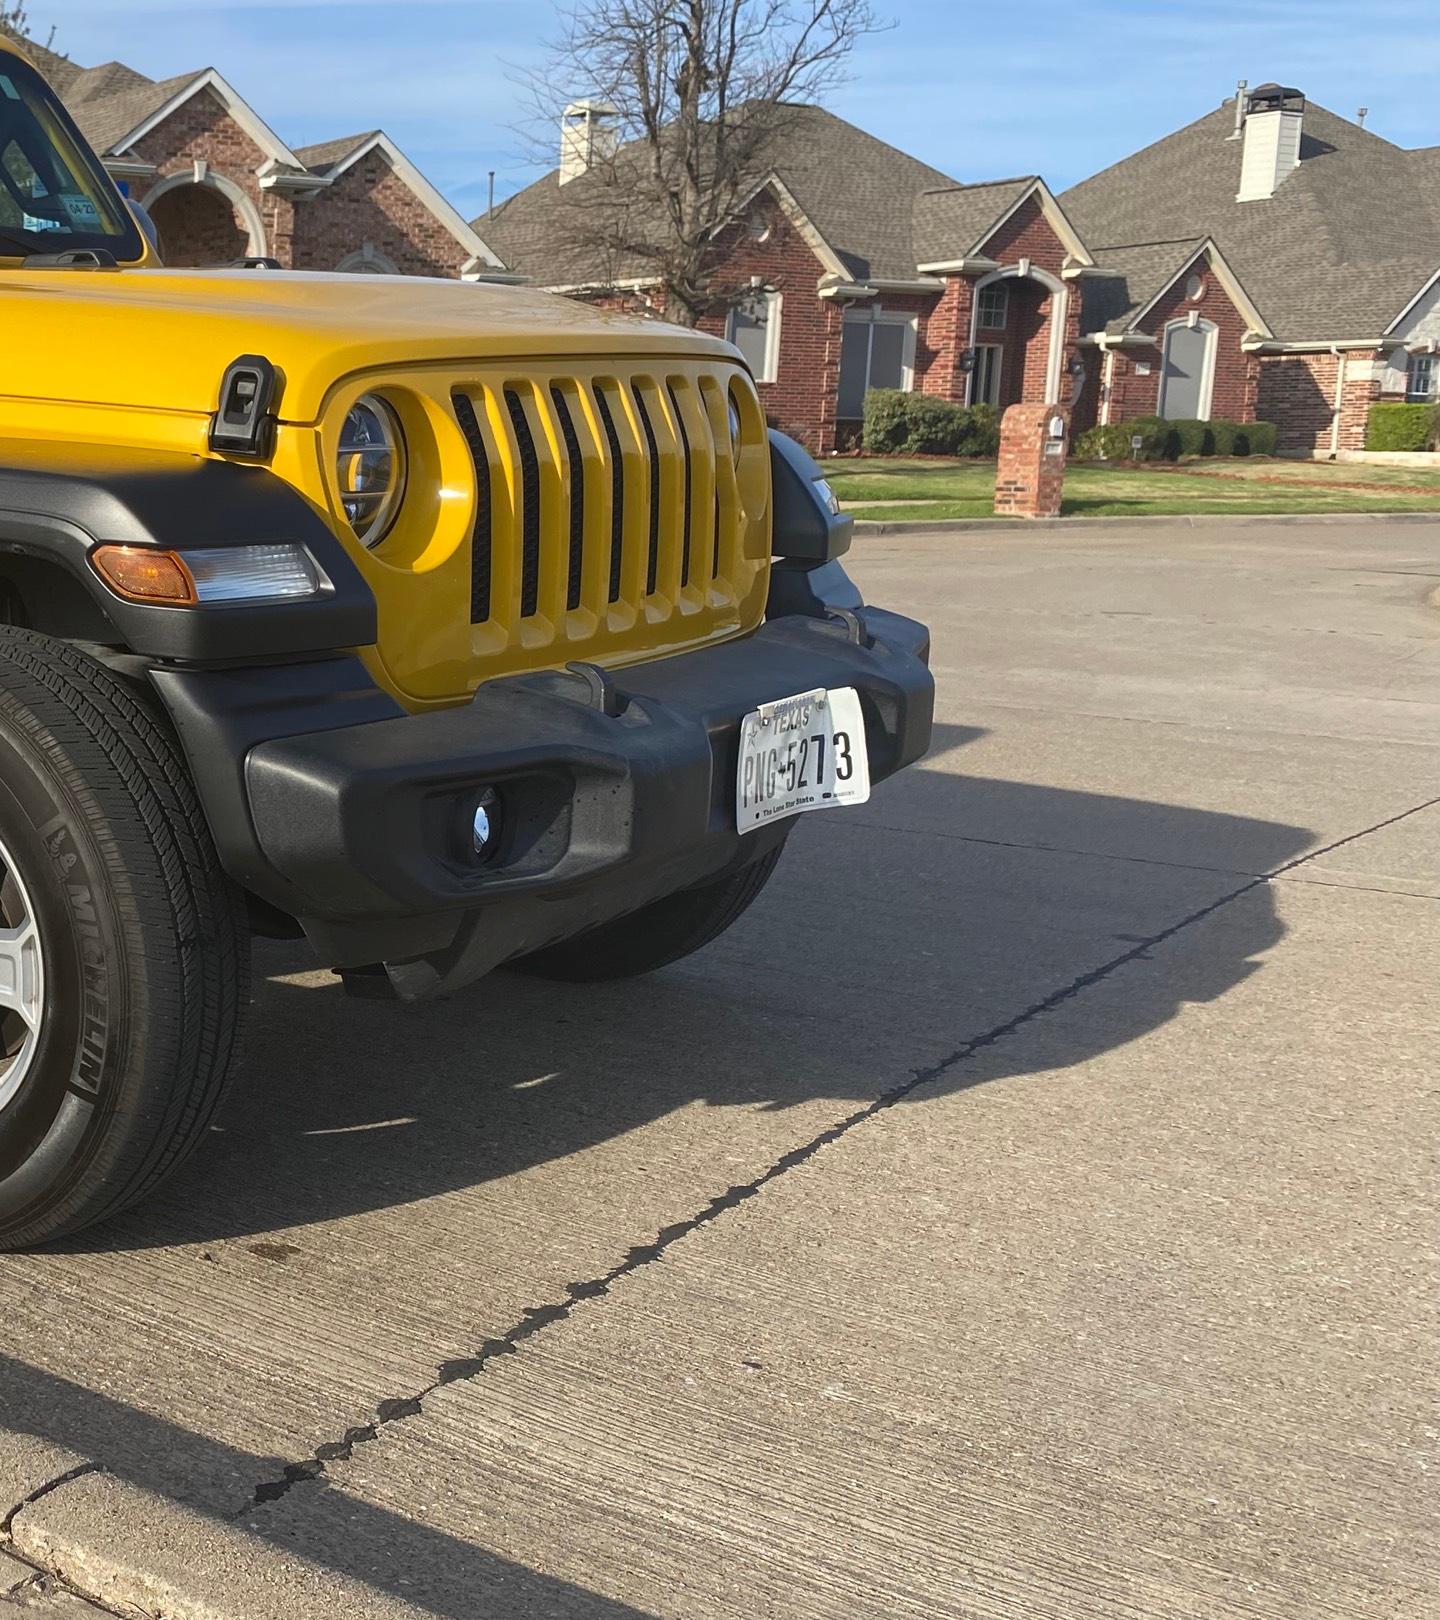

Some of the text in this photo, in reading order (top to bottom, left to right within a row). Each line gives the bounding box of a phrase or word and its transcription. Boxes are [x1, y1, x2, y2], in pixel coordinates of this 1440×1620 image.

[773, 706, 810, 735] TEXAS
[773, 805, 785, 813] Lone
[785, 801, 796, 809] Star
[796, 796, 815, 805] State
[67, 884, 109, 1093] MICHELIN
